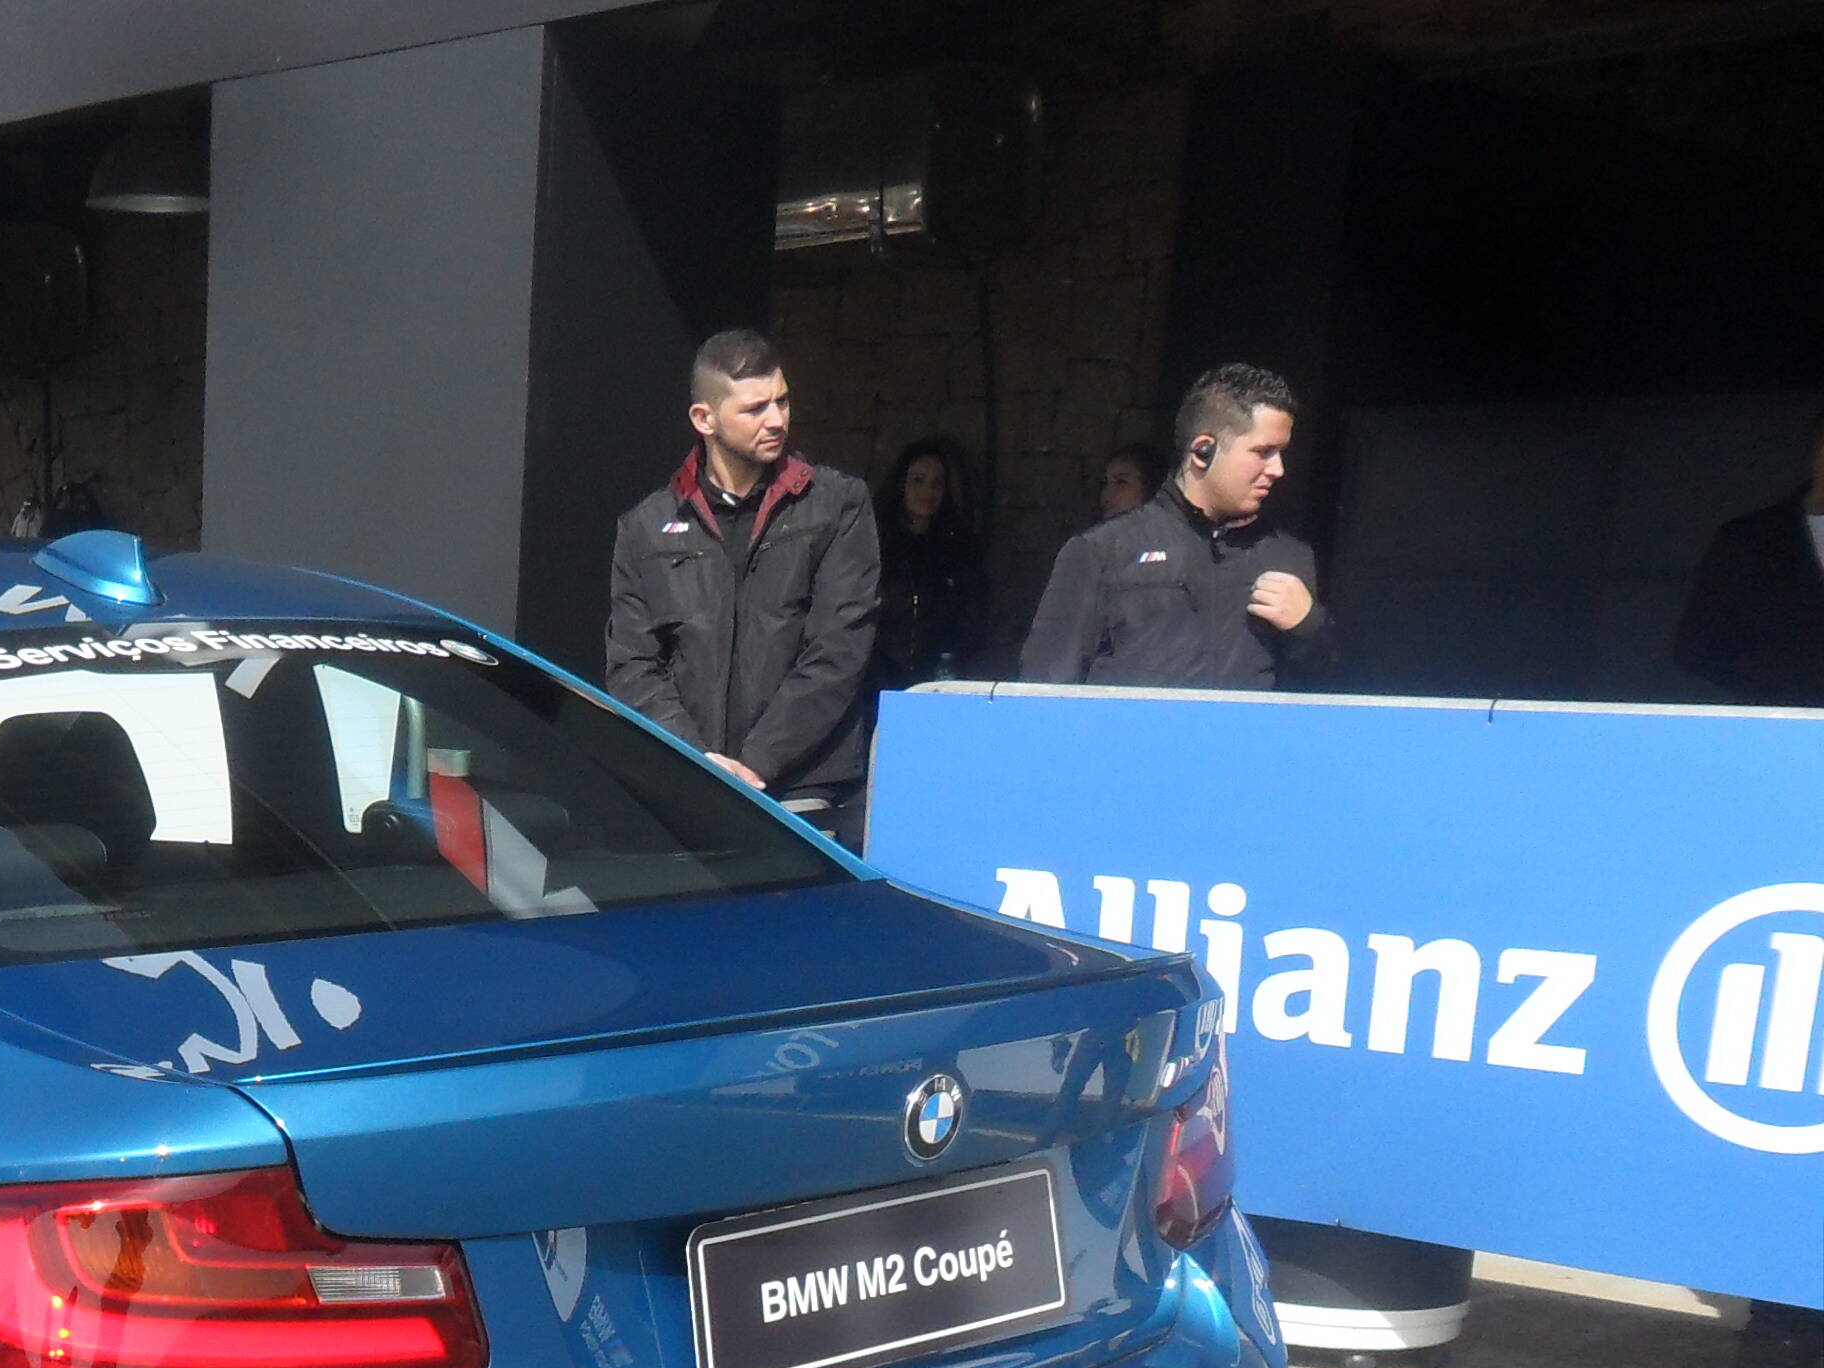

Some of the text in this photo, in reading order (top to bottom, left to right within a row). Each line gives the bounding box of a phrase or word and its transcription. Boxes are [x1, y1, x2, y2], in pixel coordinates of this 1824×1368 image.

[190, 630, 450, 657] Financeiros
[761, 1229, 1015, 1323] BMW M2 Coupé
